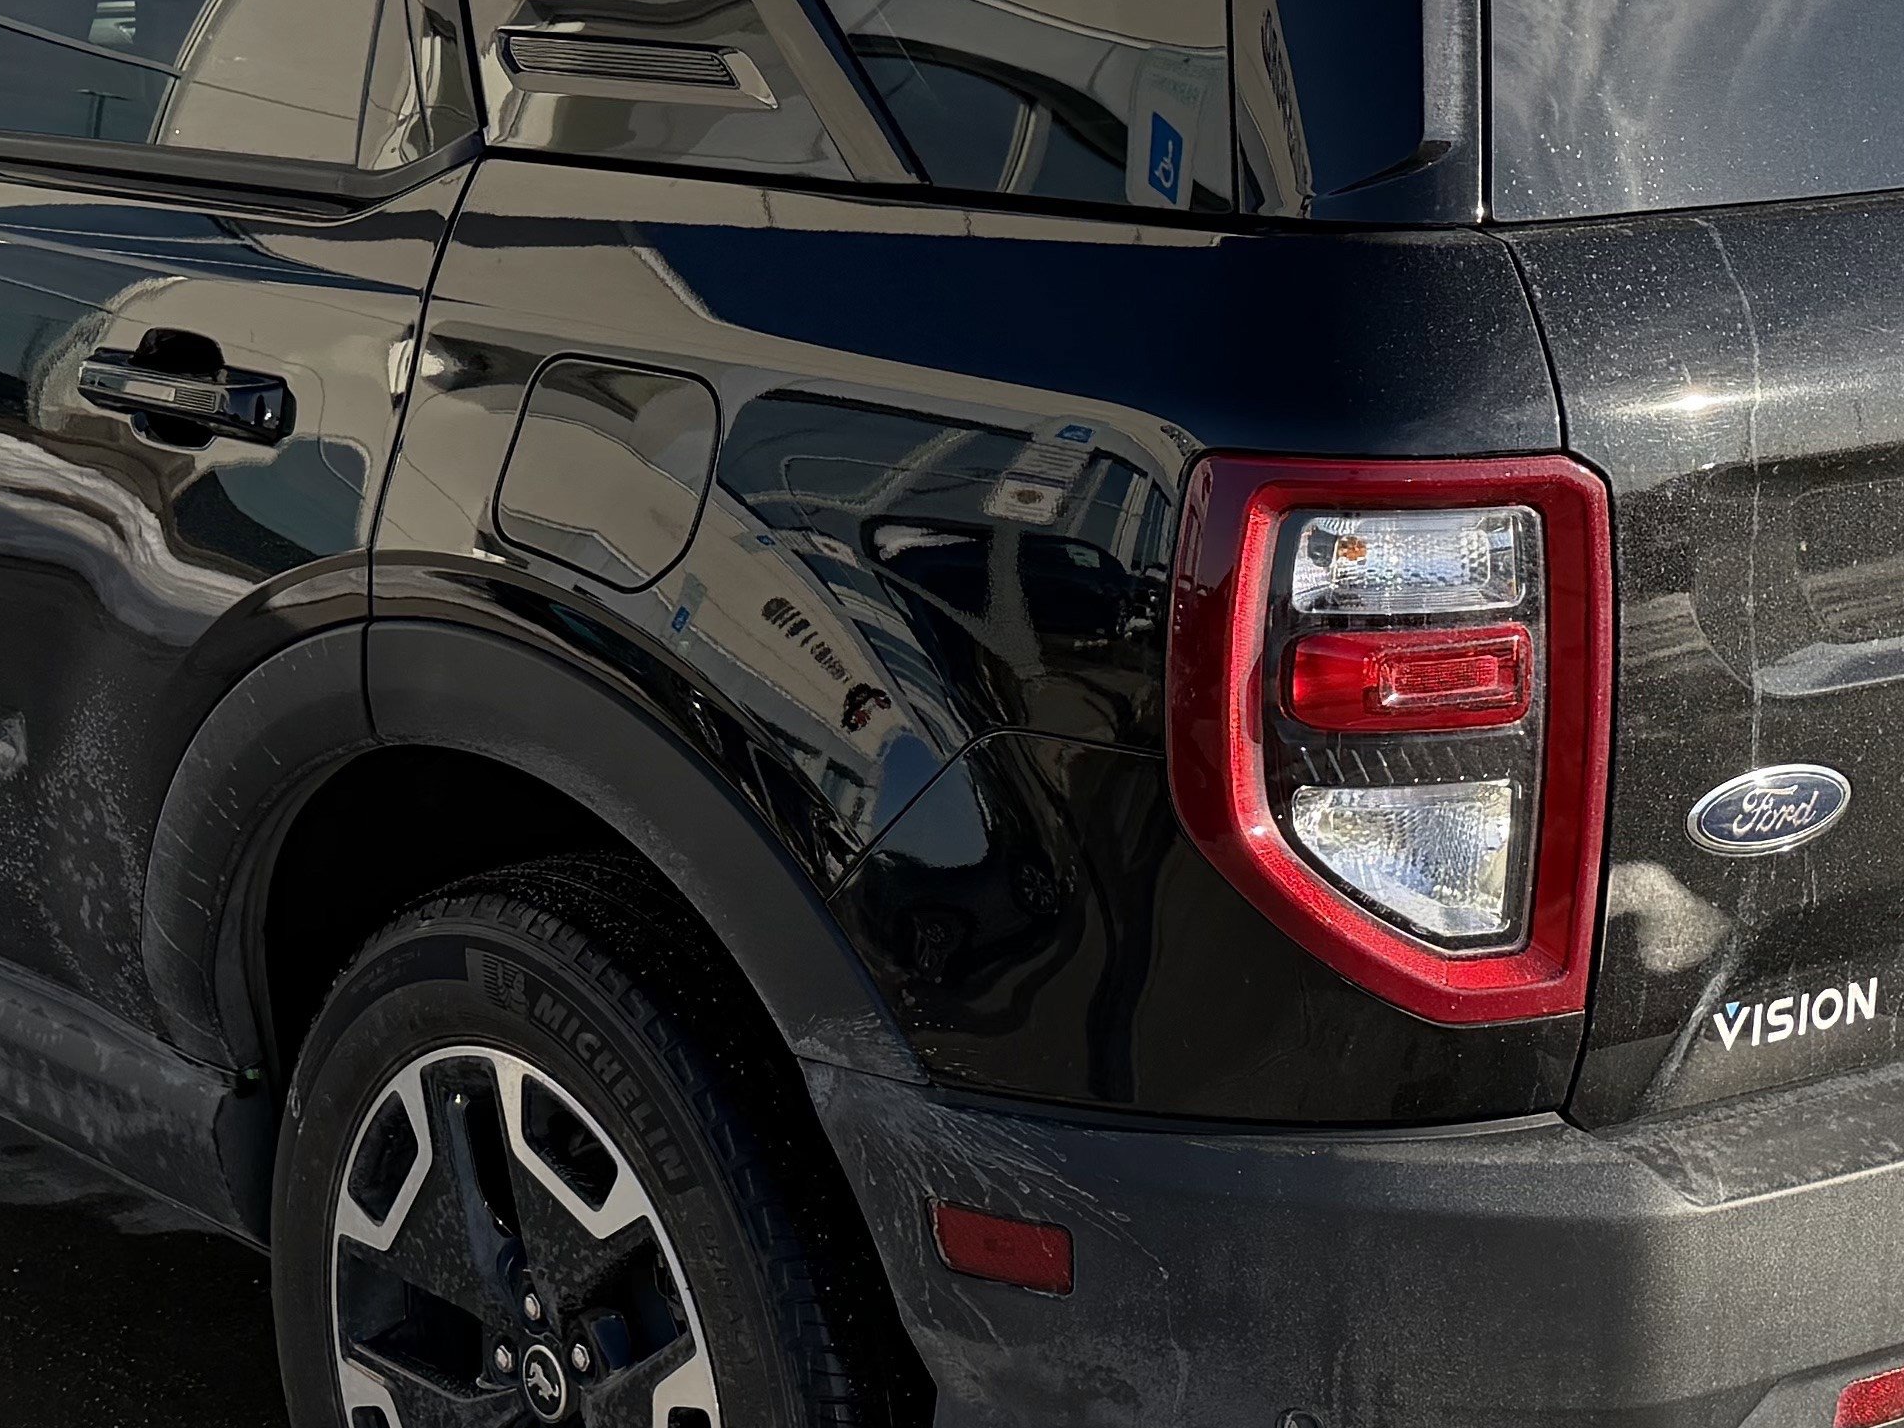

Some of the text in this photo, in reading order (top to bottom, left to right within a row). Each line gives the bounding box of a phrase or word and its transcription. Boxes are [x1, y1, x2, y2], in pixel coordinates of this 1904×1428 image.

[1730, 784, 1822, 839] Ford
[1712, 977, 1879, 1052] VISION
[533, 991, 691, 1185] MICHELIN
